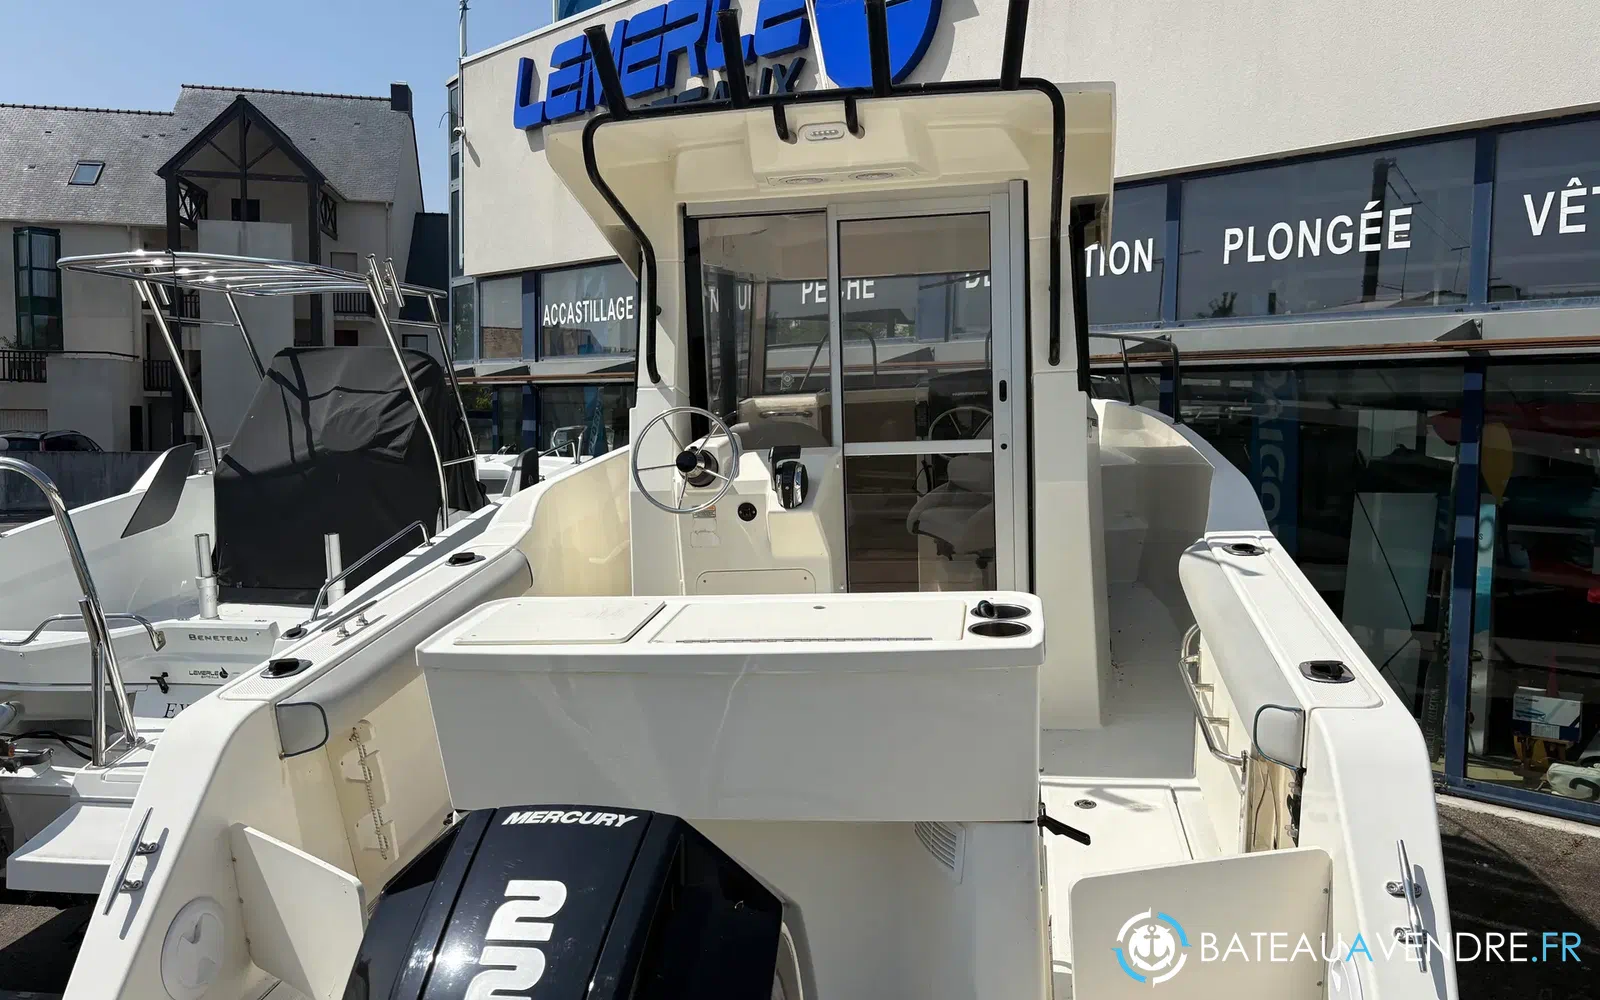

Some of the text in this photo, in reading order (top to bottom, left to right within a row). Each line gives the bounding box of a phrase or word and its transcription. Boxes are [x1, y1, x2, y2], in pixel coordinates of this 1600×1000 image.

[1522, 176, 1600, 236] VÊ
[1222, 200, 1413, 264] PLONGÉE
[542, 295, 634, 326] ACCASTILLAGE
[502, 810, 638, 828] MERCURY
